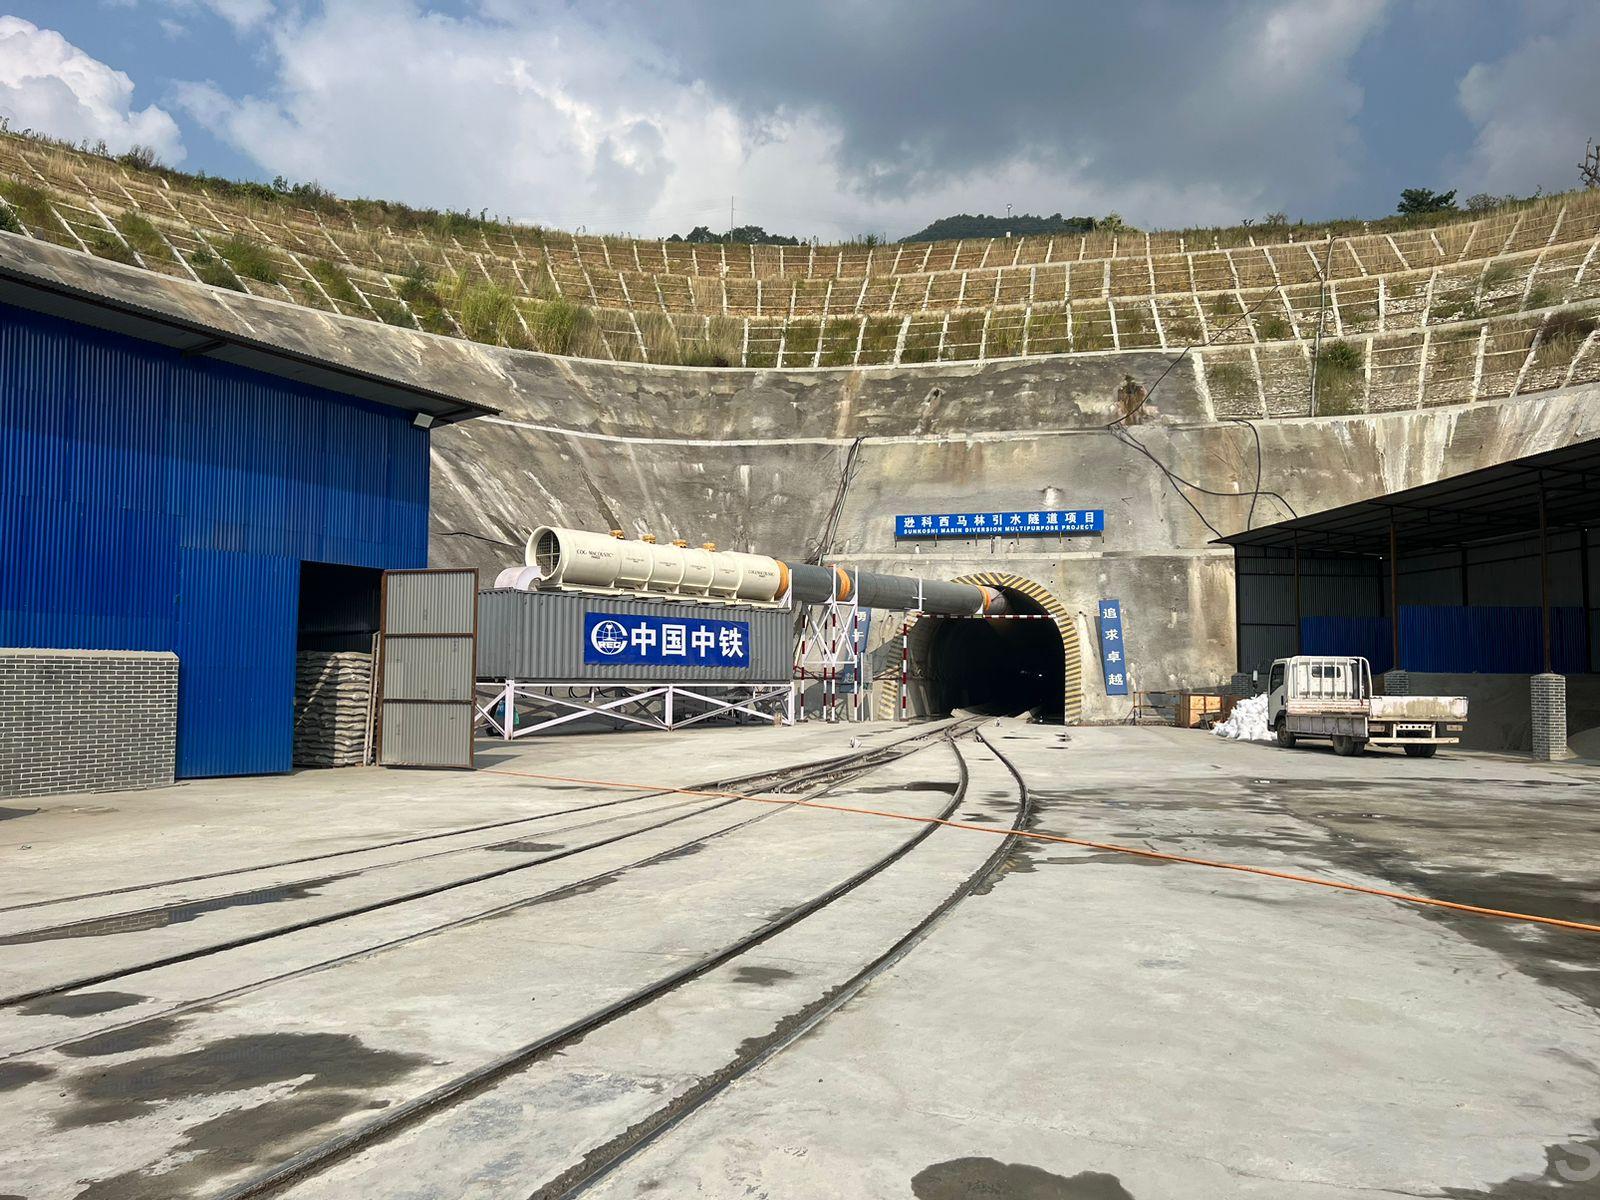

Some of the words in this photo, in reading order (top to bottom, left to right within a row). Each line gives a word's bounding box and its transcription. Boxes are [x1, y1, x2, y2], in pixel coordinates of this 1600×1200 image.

[631, 621, 744, 658] 中国中铁
[1102, 607, 1124, 686] 追求卓越
